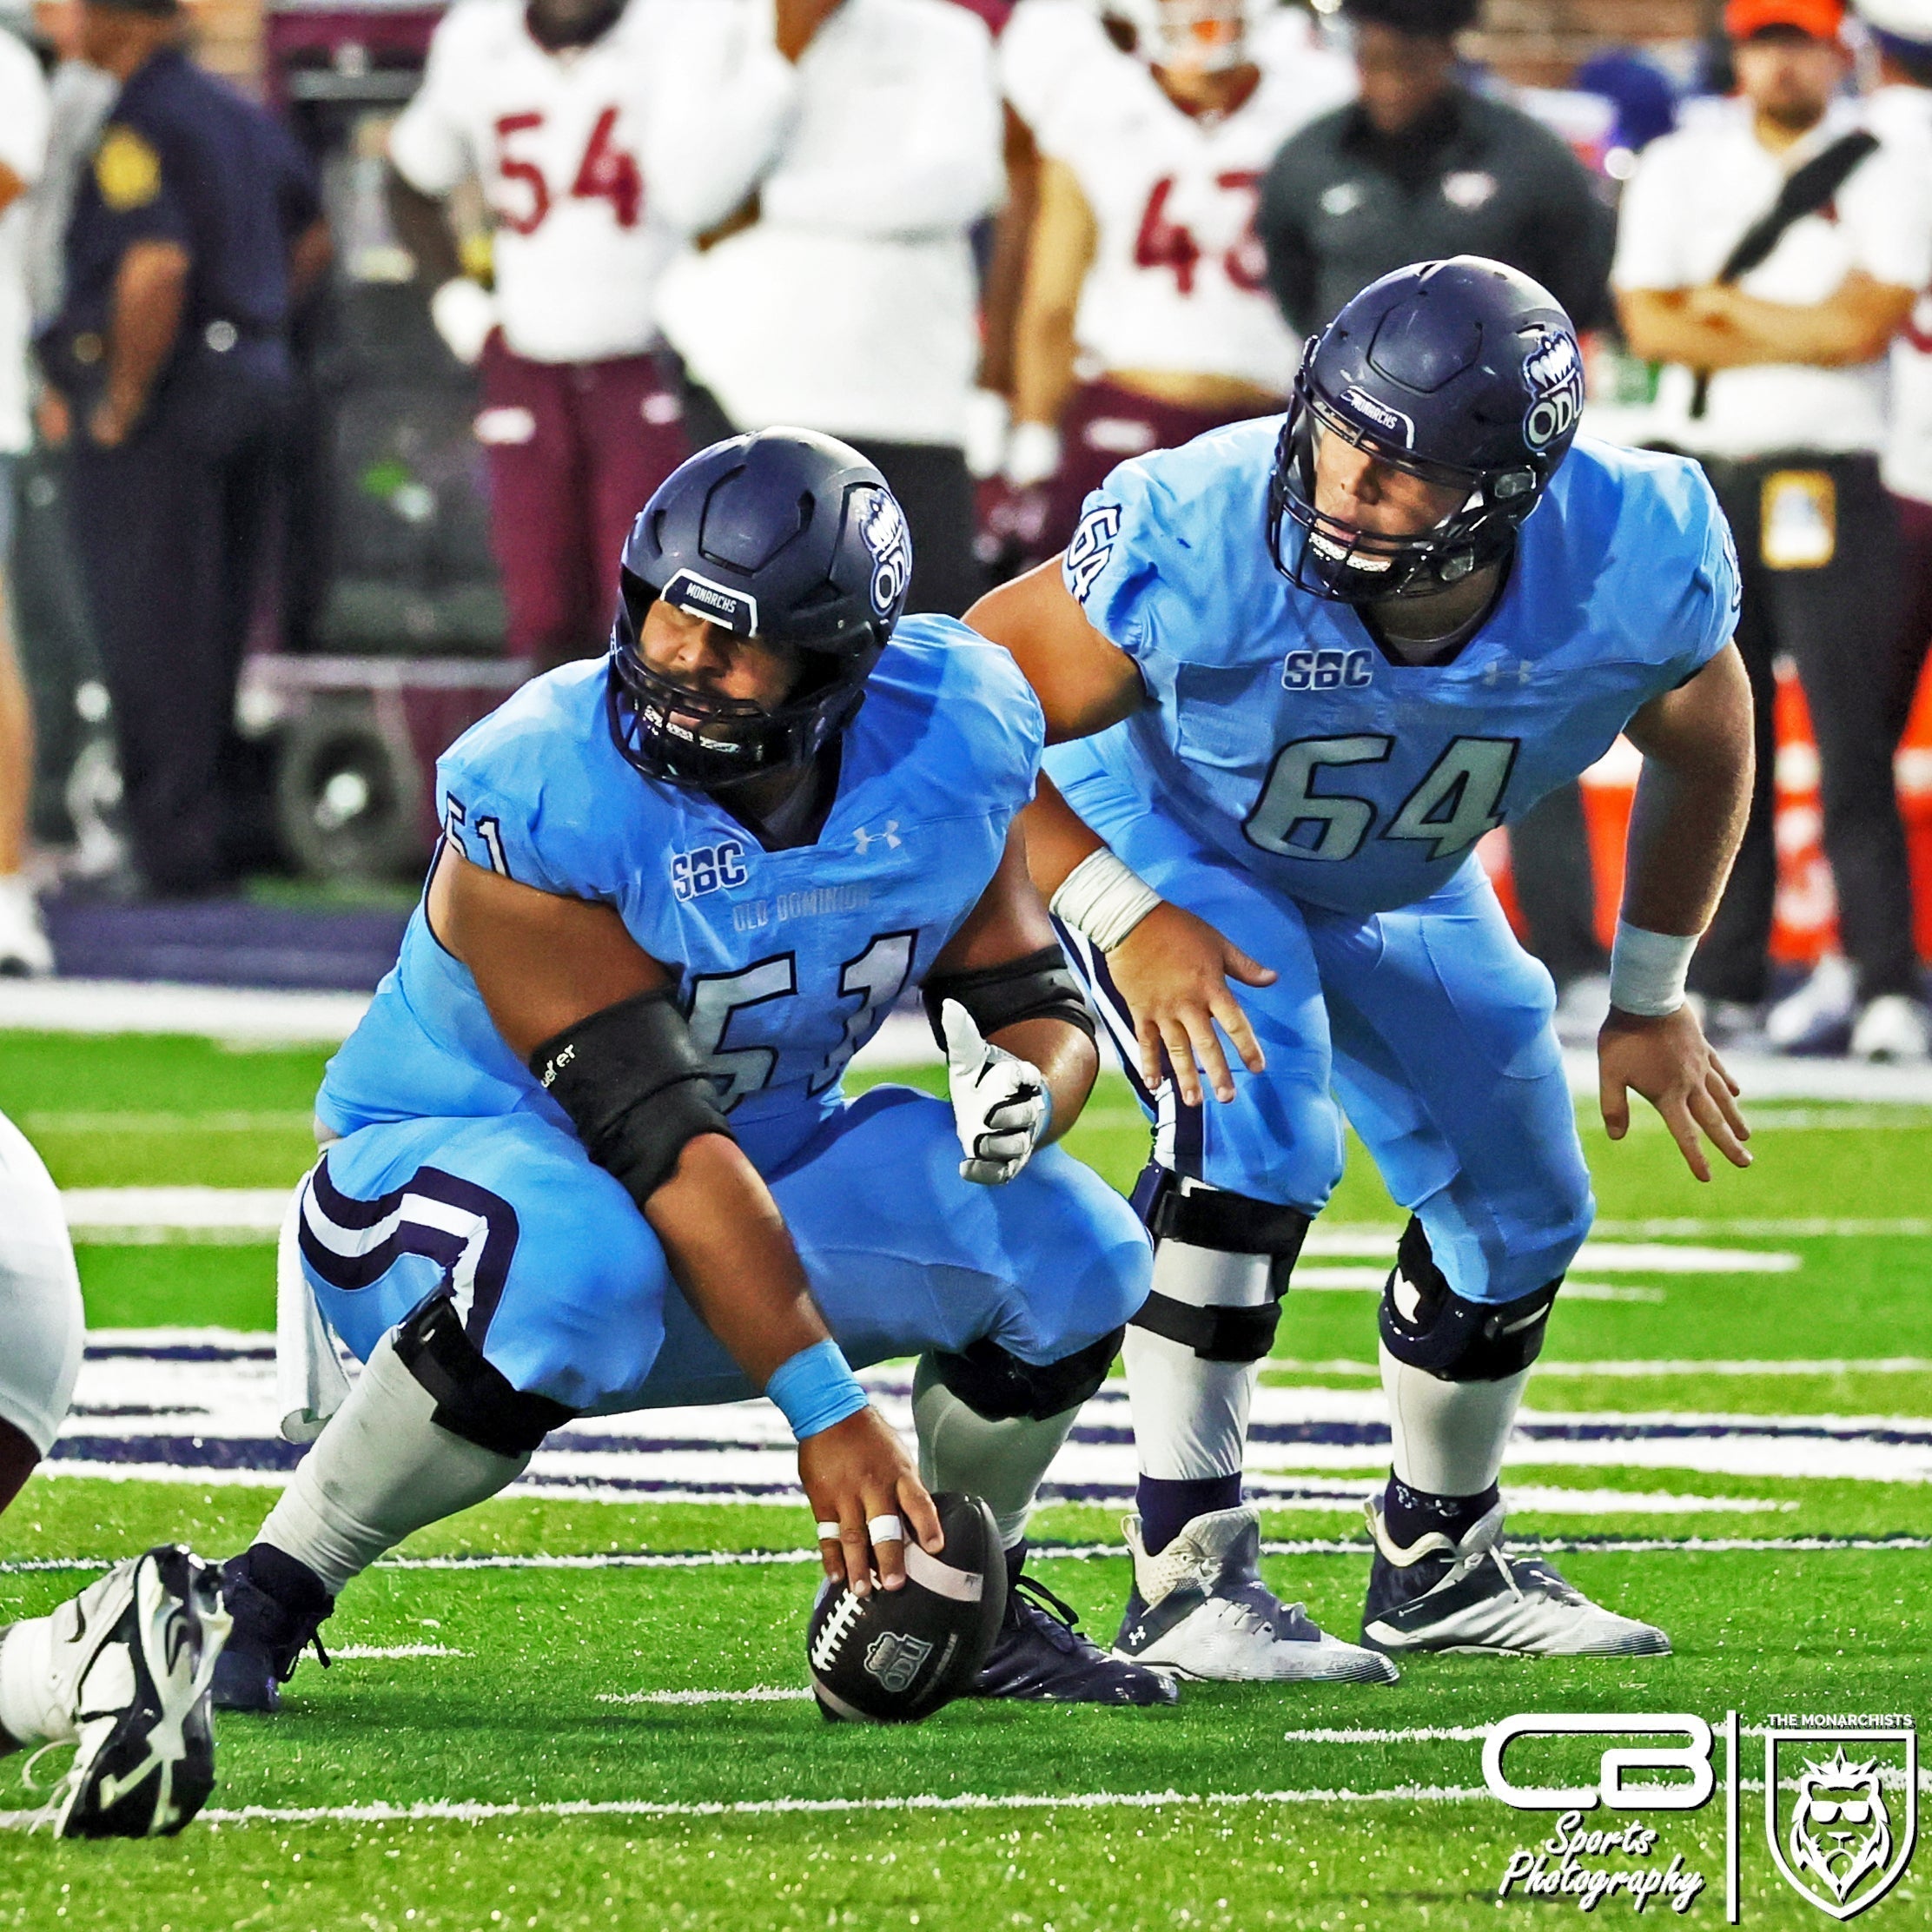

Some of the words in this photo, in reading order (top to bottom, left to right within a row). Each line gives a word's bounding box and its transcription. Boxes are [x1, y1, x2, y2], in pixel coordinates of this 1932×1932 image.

[495, 106, 643, 235] 54
[1528, 371, 1582, 445] ODU
[1067, 504, 1122, 605] 64
[686, 582, 737, 614] MONARCHS
[1281, 648, 1374, 691] SBC
[1241, 733, 1520, 863] 64
[670, 838, 748, 903] SBC
[732, 900, 770, 932] OLD
[686, 927, 919, 1117] 51
[883, 1640, 925, 1688] ODU
